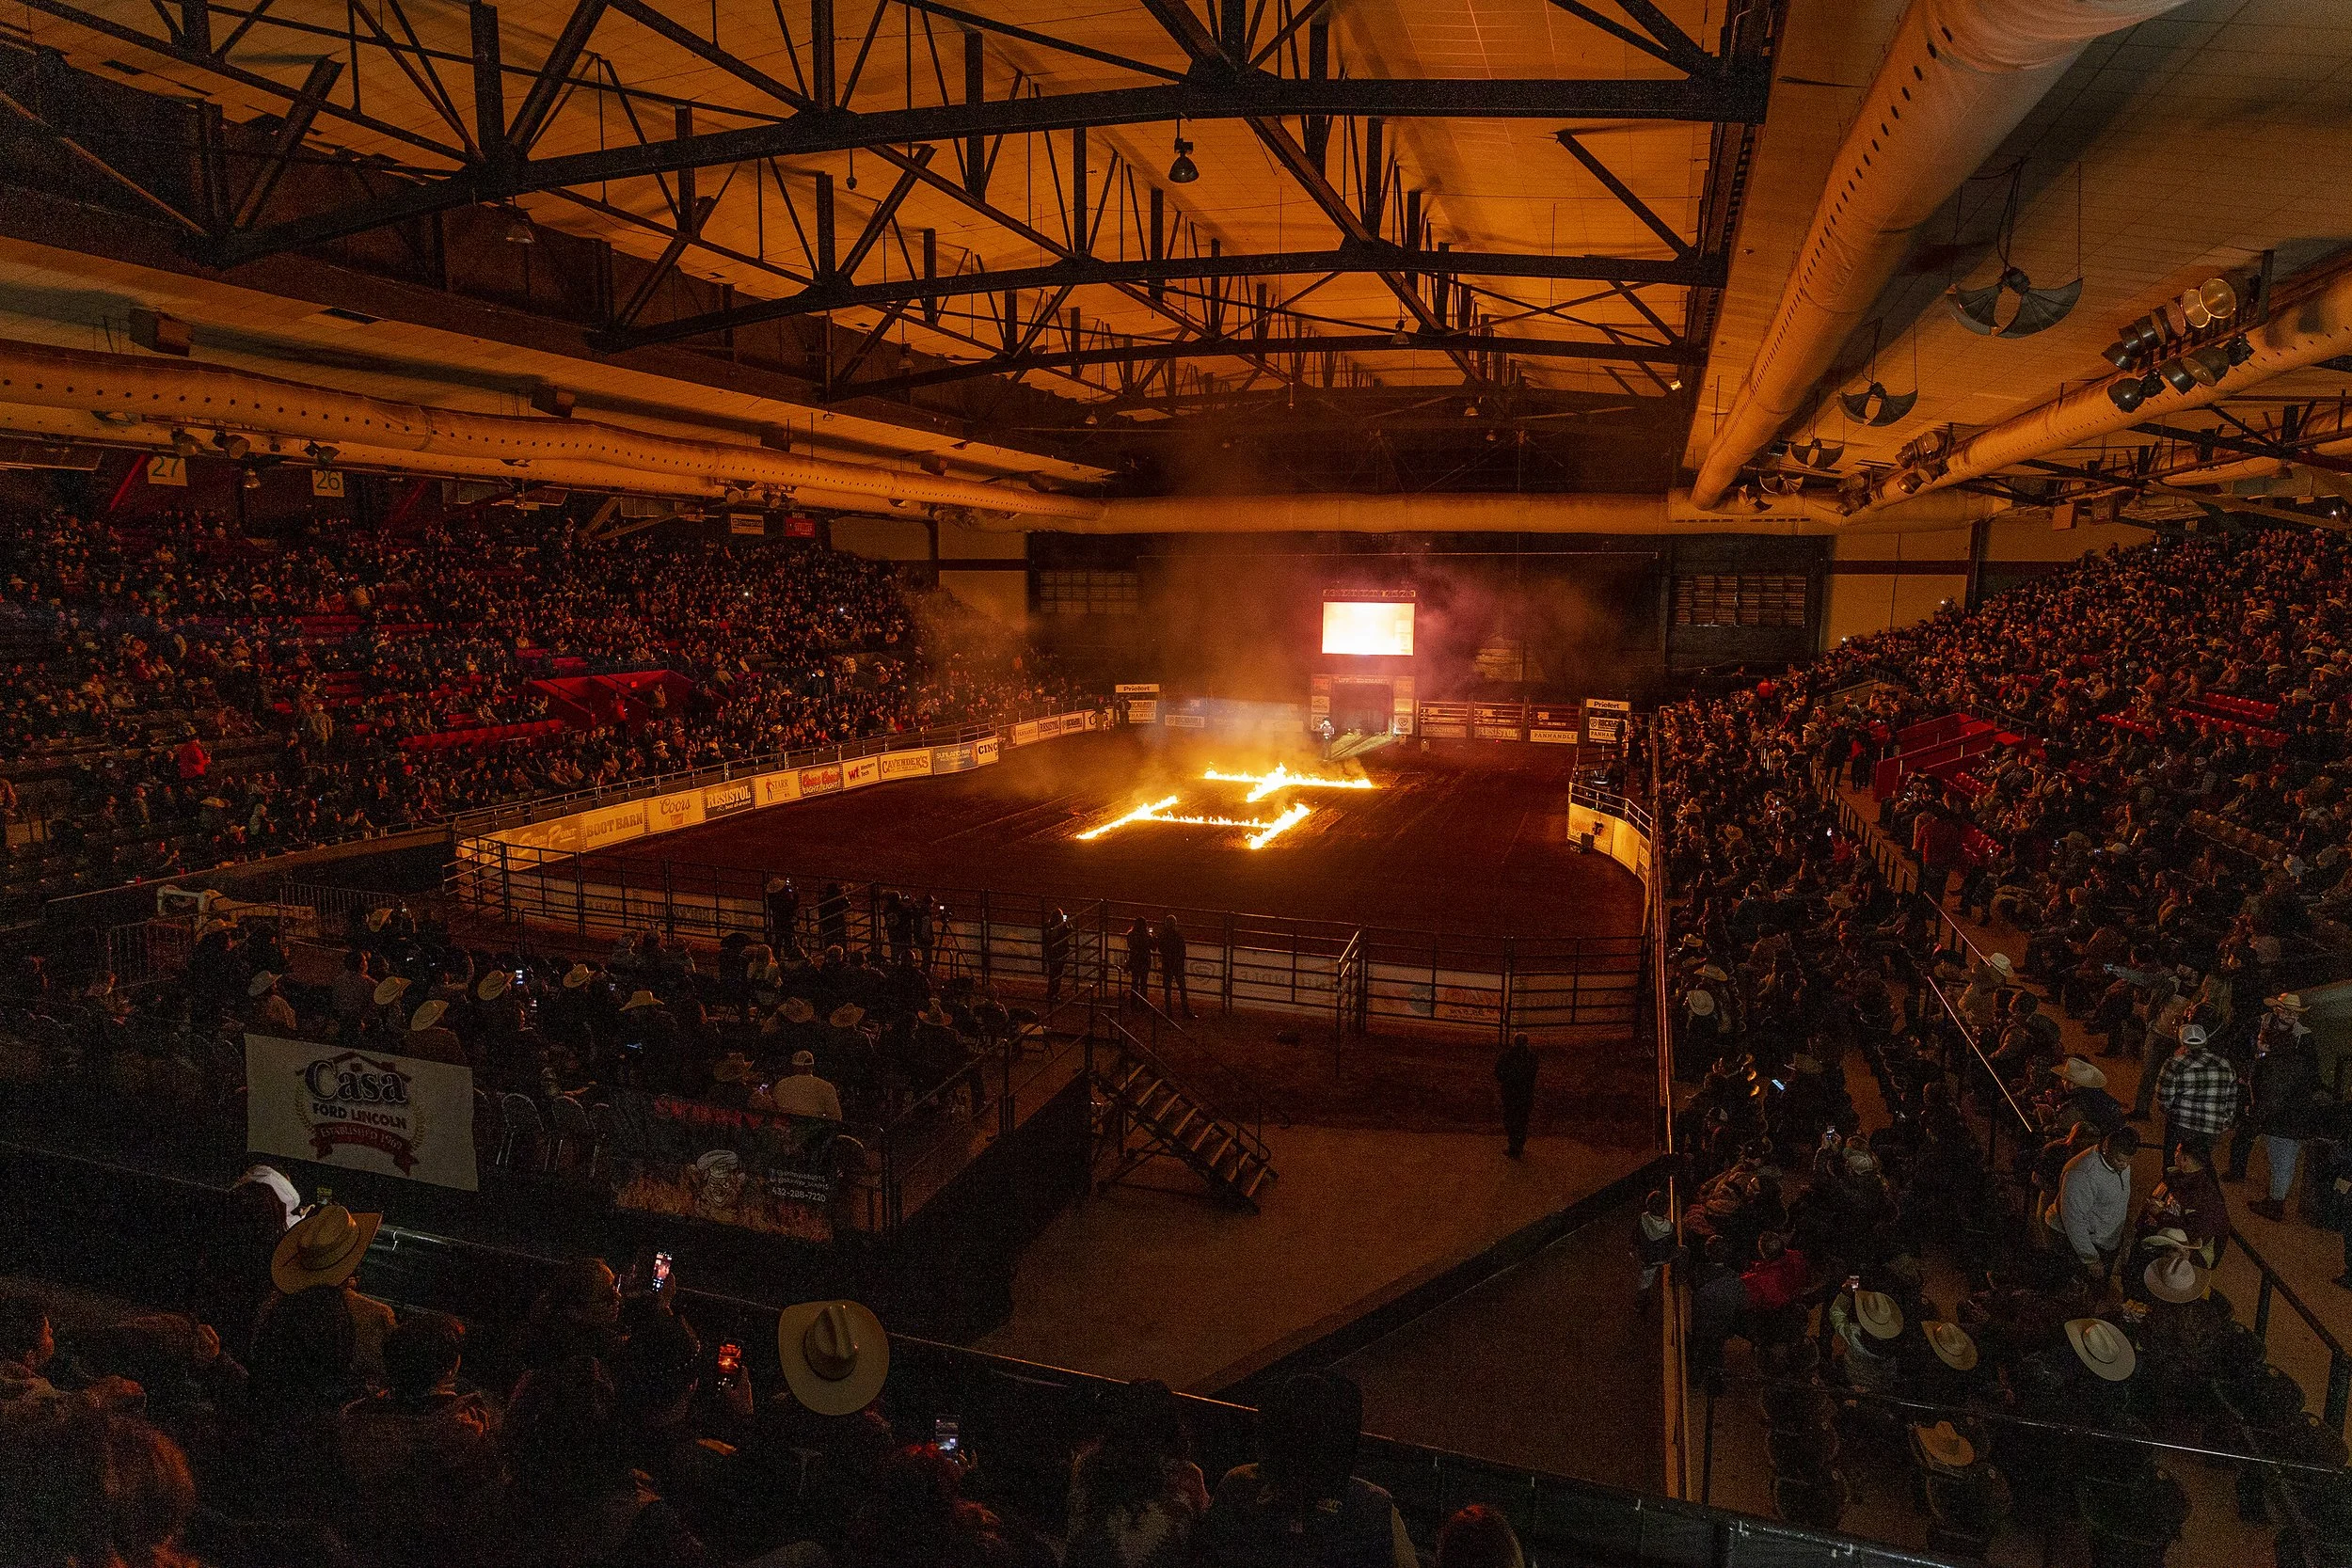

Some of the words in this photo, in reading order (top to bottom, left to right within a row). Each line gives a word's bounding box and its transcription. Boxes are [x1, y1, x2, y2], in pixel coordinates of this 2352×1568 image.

[151, 456, 182, 478] 27
[316, 469, 342, 490] 26
[1594, 701, 1620, 709] Priefert
[1479, 726, 1518, 737] RESISTOL
[977, 741, 998, 754] CINC
[882, 755, 930, 773] CAVENDER'S
[707, 785, 752, 809] RESISTOL
[803, 784, 820, 795] LIGHT
[822, 780, 840, 791] LIGHT
[660, 798, 691, 816] Coors
[585, 819, 614, 838] BOOT
[615, 812, 644, 831] BARN
[305, 1059, 409, 1103] Casa
[312, 1102, 347, 1119] FORD
[351, 1107, 407, 1130] LINCOLN
[320, 1125, 377, 1142] ESTABLISHED
[379, 1131, 403, 1149] 1969
